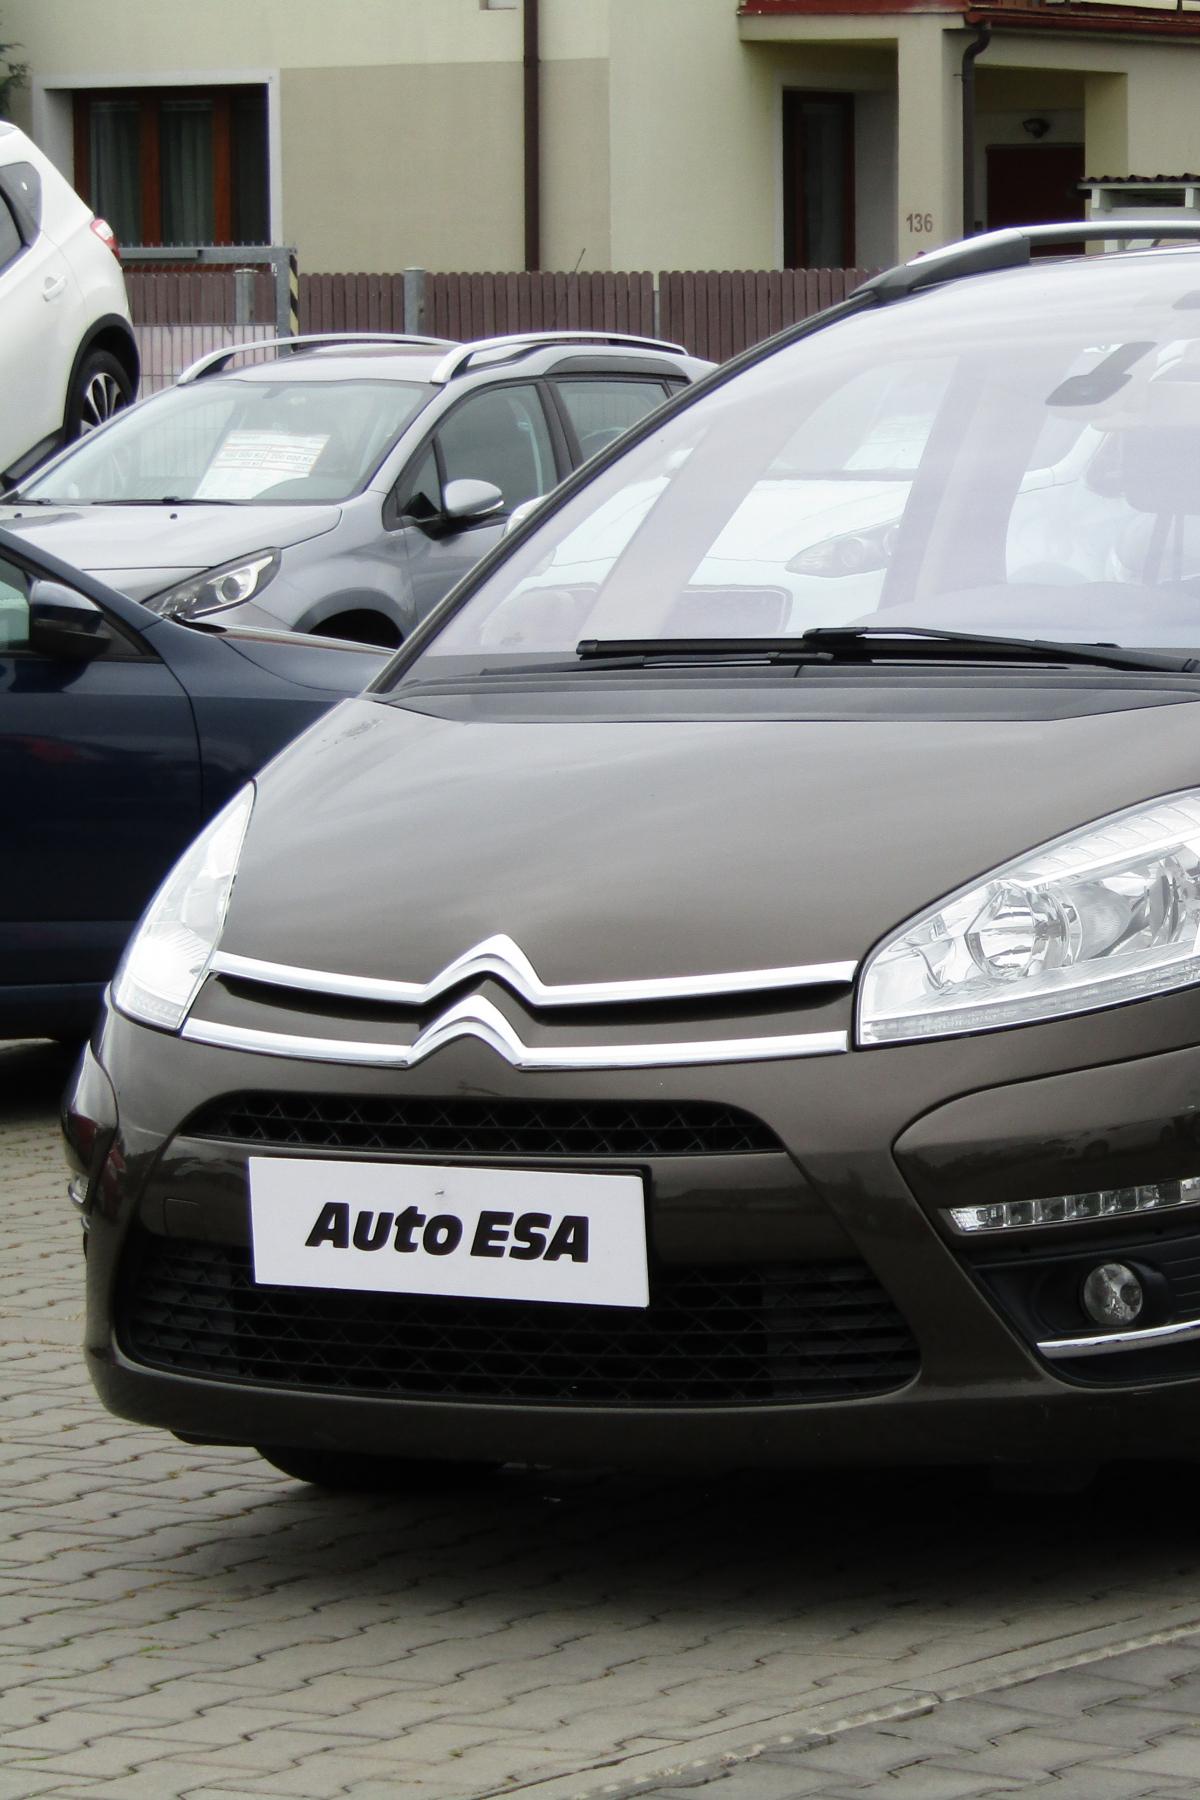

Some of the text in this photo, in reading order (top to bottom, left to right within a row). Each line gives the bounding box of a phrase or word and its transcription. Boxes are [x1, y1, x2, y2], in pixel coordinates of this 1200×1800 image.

[906, 213, 934, 233] 136
[304, 1201, 589, 1263] Auto ESA
